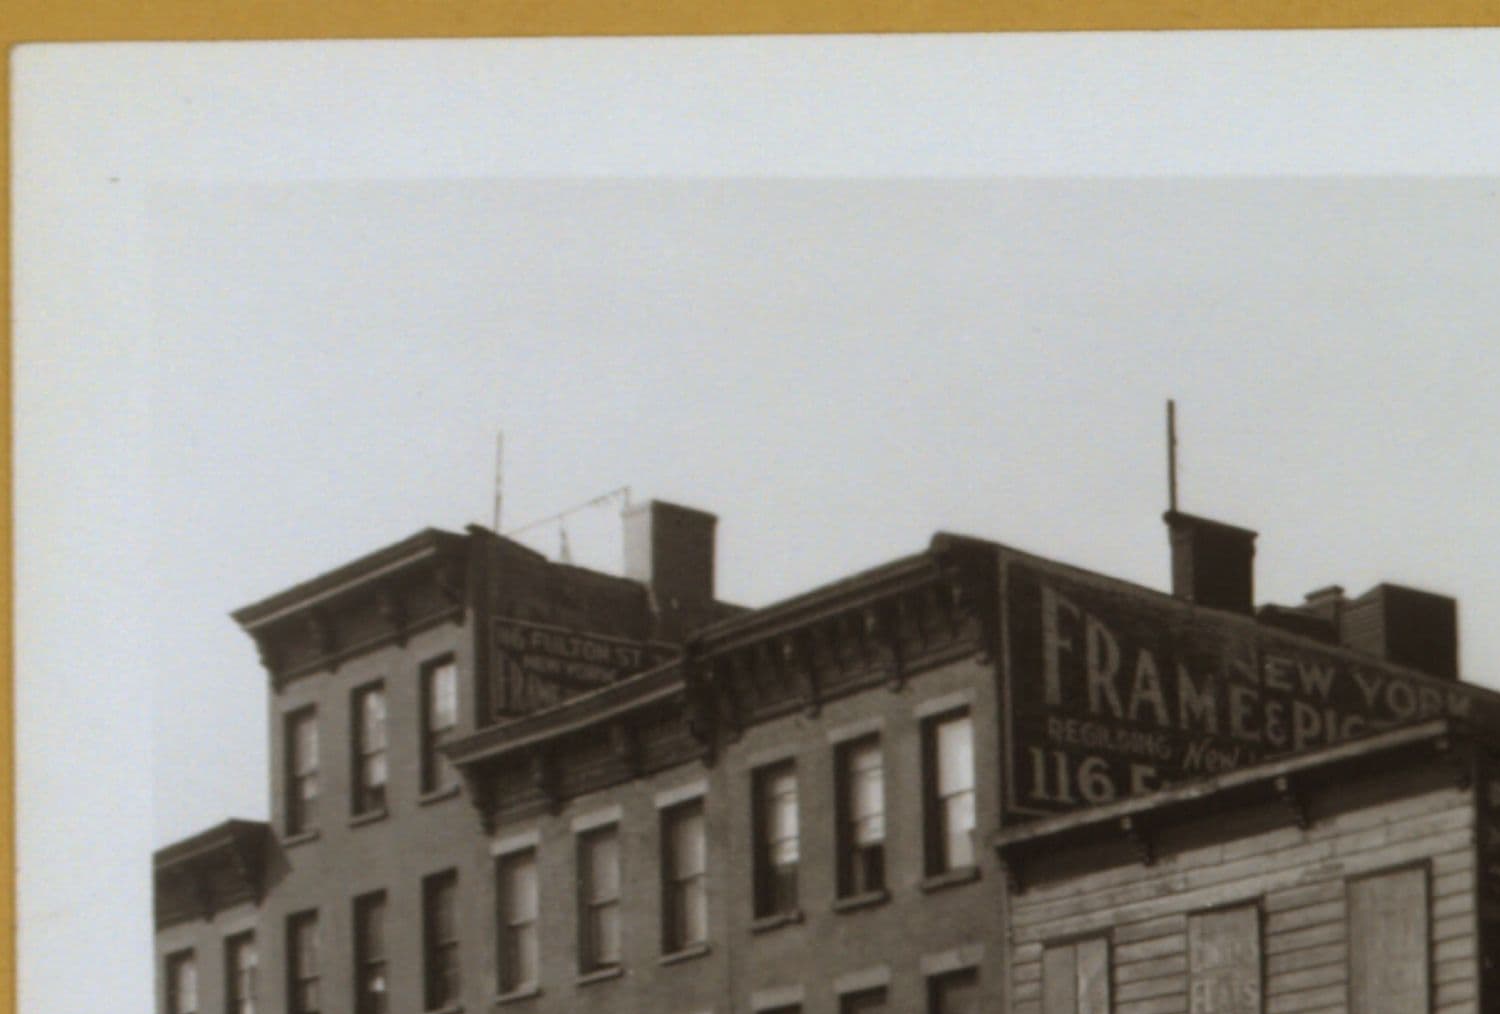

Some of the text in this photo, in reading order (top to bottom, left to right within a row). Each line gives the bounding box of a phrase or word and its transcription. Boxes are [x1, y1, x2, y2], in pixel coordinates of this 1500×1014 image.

[1041, 584, 1261, 741] FRAME
[1264, 699, 1287, 744] &
[1221, 635, 1338, 698] NEW
[1027, 745, 1117, 804] 116
